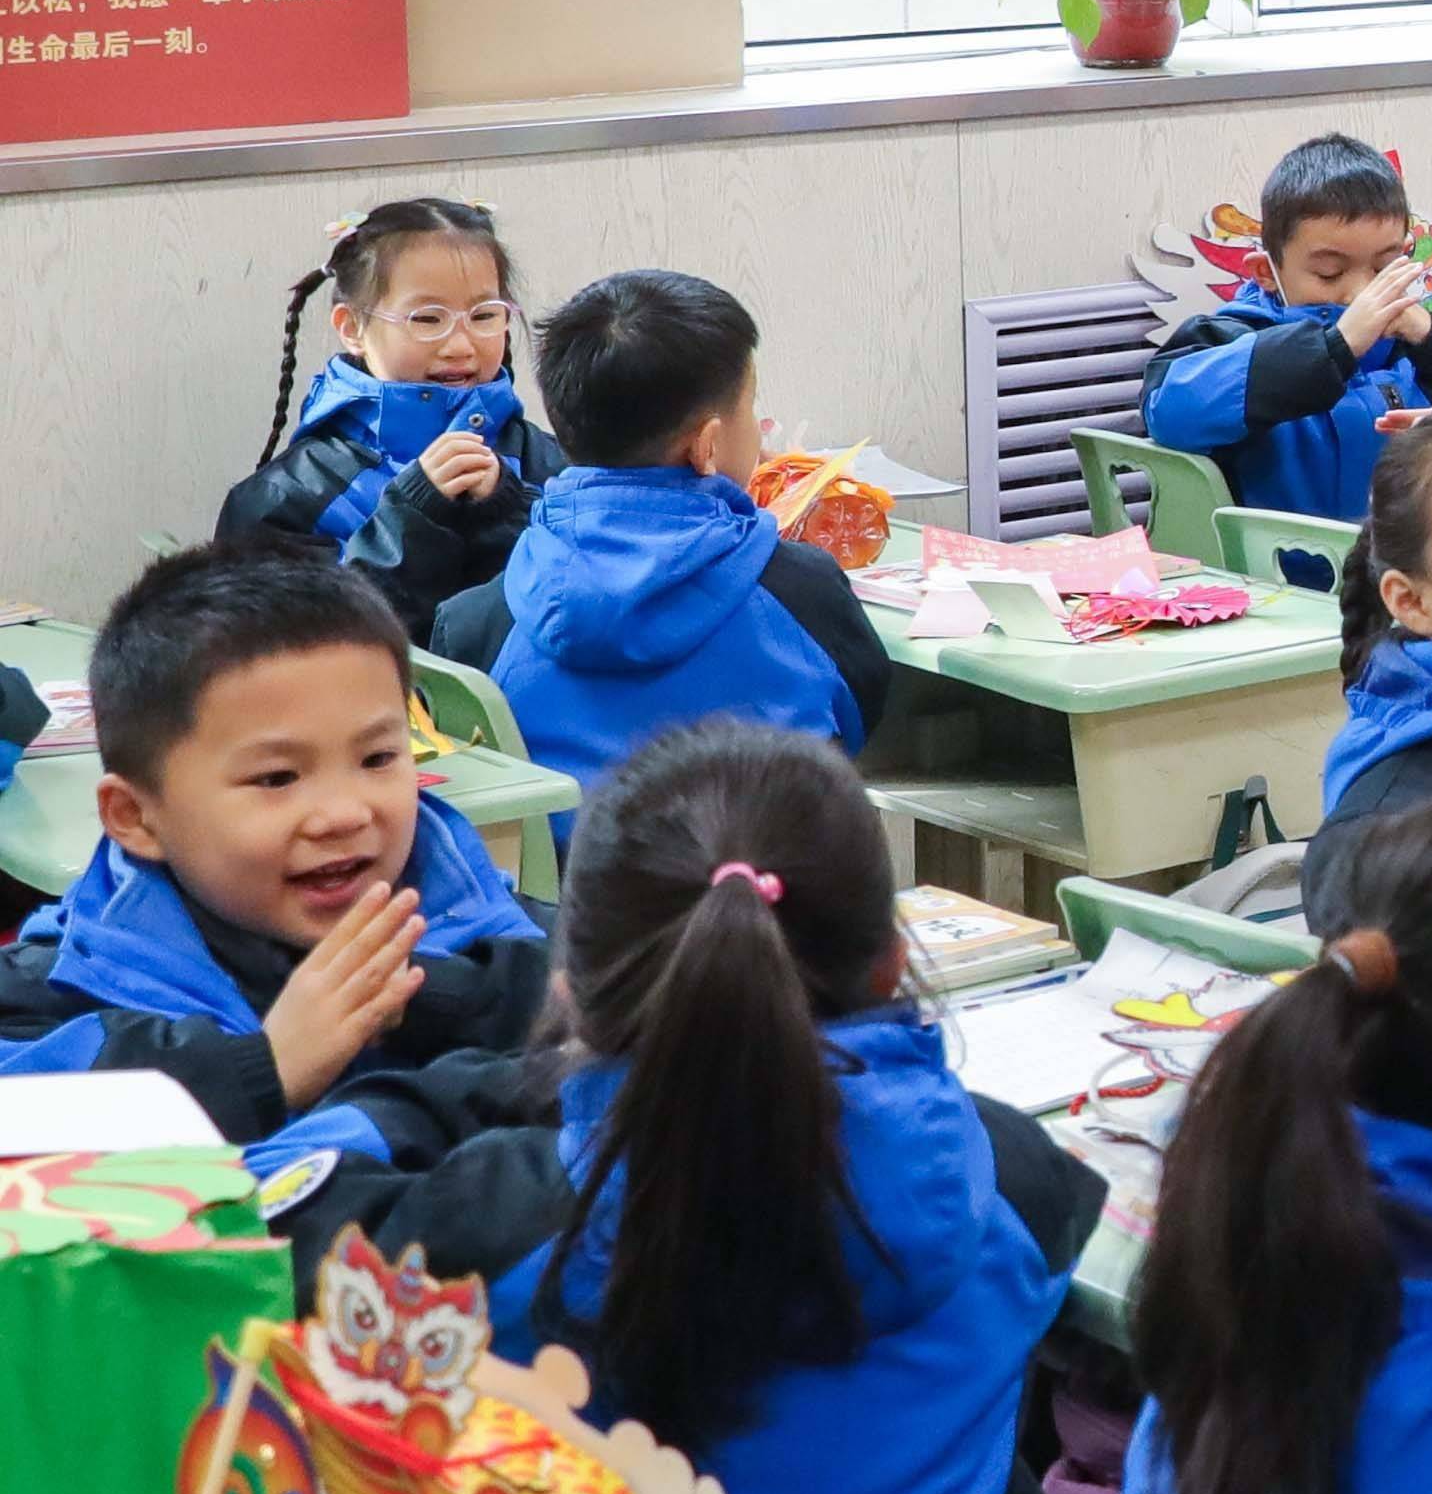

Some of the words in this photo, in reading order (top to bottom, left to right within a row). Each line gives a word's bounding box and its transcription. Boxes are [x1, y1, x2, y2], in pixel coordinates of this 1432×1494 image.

[0, 26, 208, 66] 生命最后一刻。
